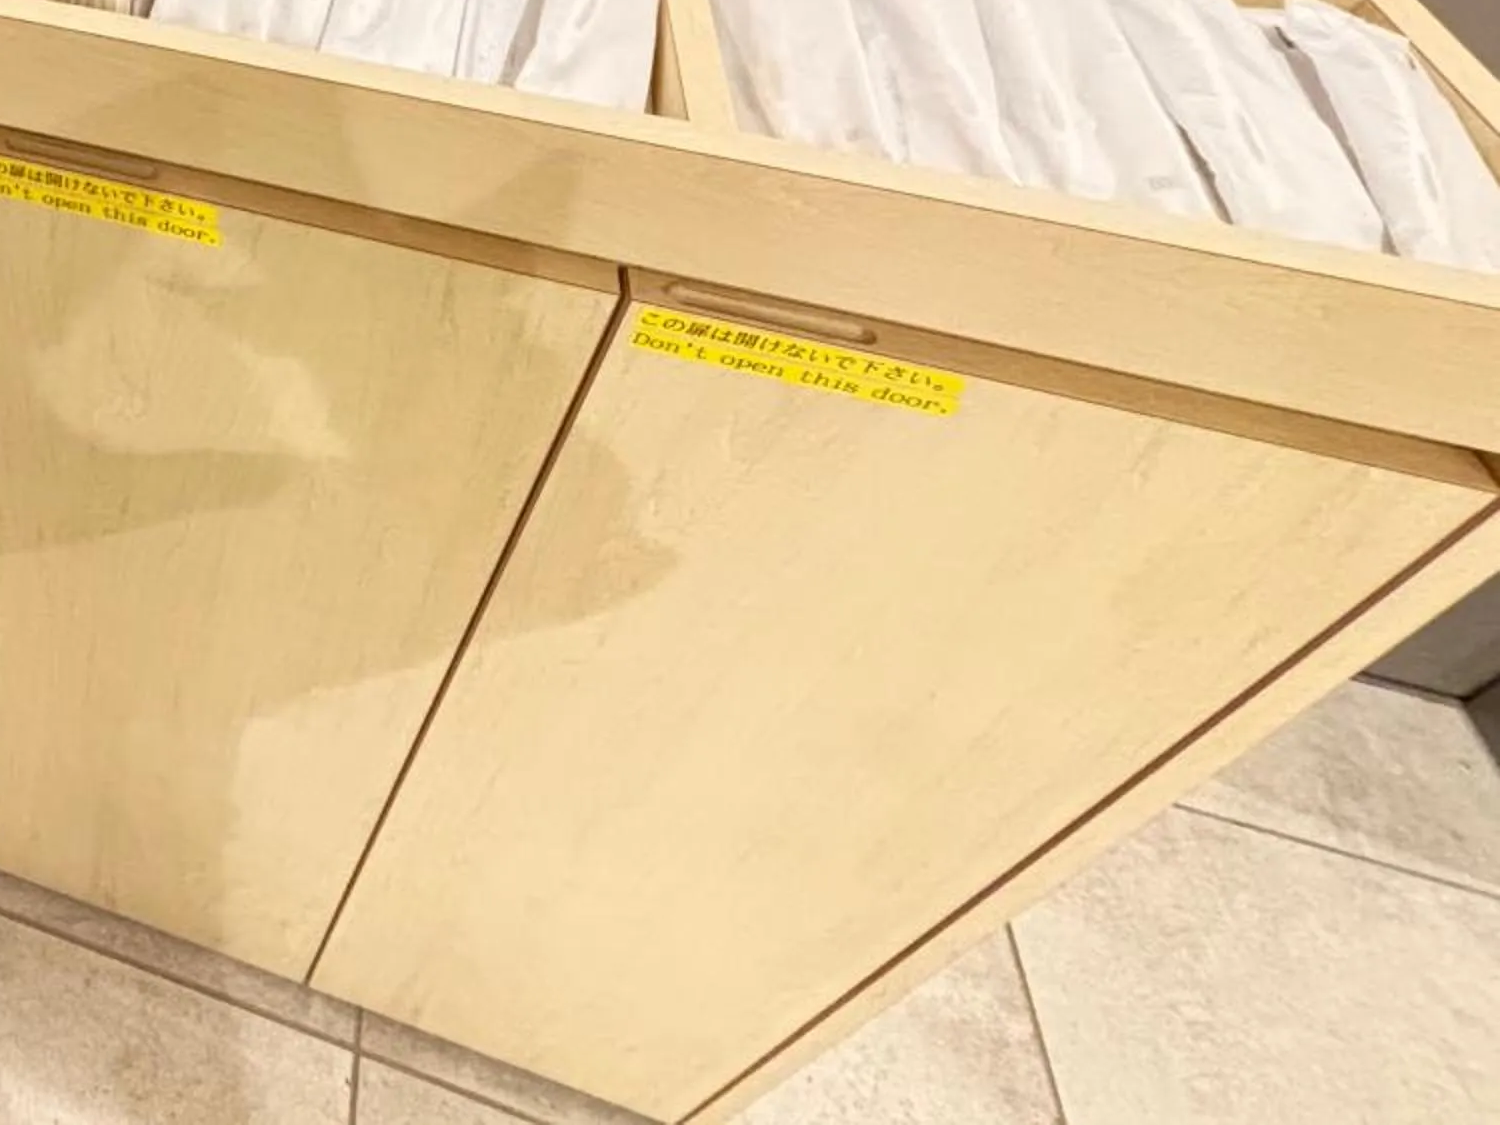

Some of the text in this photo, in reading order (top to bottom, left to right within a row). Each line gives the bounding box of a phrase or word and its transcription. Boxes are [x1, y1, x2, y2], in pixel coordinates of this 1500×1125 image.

[42, 192, 92, 216] open
[102, 205, 149, 229] this
[156, 218, 218, 245] door.
[632, 330, 950, 416] Don't open this door.
[639, 311, 946, 393] この扉は開けないで下さい。
